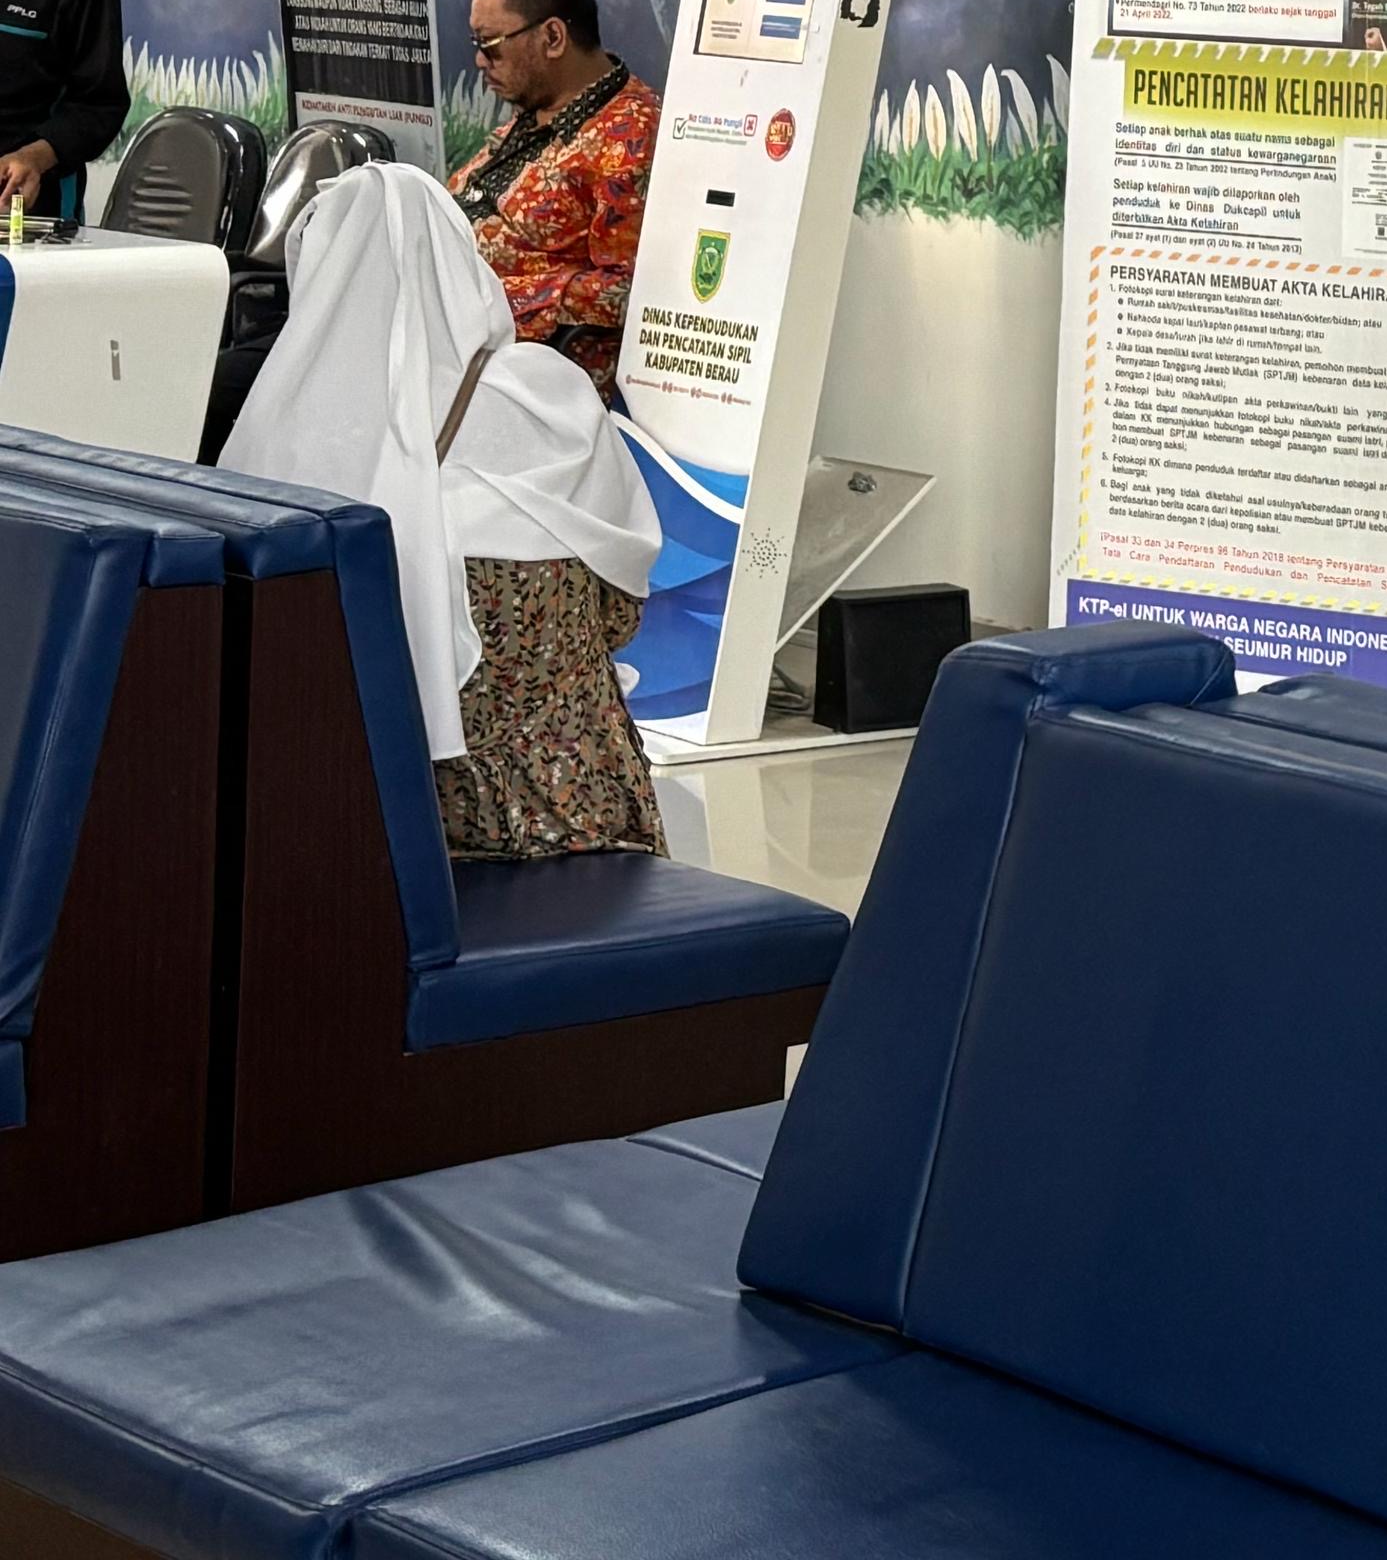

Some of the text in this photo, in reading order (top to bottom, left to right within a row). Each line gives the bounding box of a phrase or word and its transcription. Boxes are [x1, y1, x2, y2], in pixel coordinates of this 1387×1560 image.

[1133, 69, 1267, 111] PENCATATAN
[1113, 178, 1300, 204] Setiap kelahiran wajib dilaporkan oleh
[1110, 264, 1206, 288] PERSYARATAN
[1209, 273, 1277, 293] MEMBUAT
[1281, 278, 1318, 297] AKTA
[642, 306, 759, 342] DINAS KEPENDUDUKAN
[639, 329, 752, 364] DAN PENCATATAN SIPIL
[644, 351, 740, 384] KABUPATEN BERAU
[1078, 596, 1127, 619] KTP-el
[1131, 603, 1185, 626] UNTUK
[1189, 611, 1250, 635] WARGA
[1253, 618, 1323, 644] NEGARA
[1223, 636, 1347, 667] SEUMUR HIDUP
